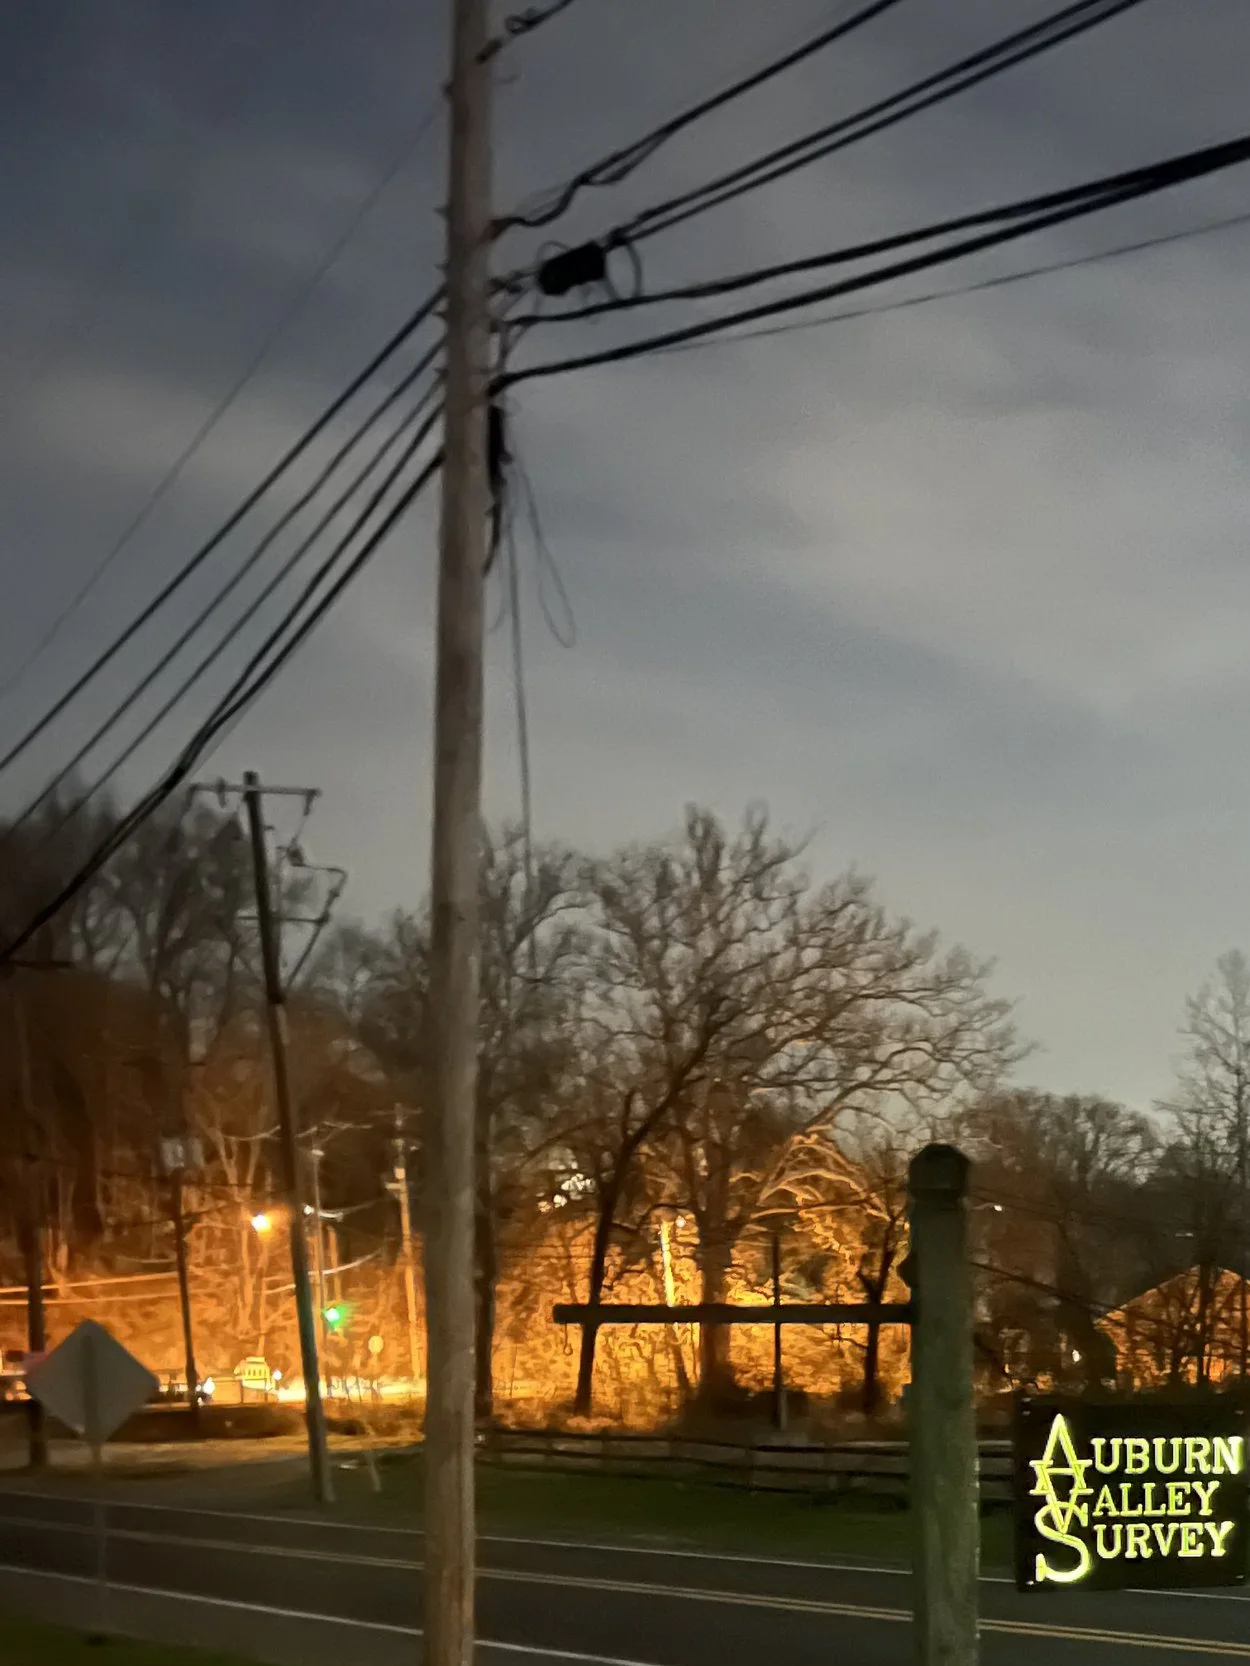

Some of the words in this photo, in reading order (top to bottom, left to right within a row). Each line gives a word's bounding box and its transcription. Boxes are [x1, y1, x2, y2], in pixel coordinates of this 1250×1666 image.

[1029, 1413, 1244, 1495] AUBURN
[1029, 1459, 1220, 1534] VALLEY
[1034, 1501, 1235, 1583] SURVEY
